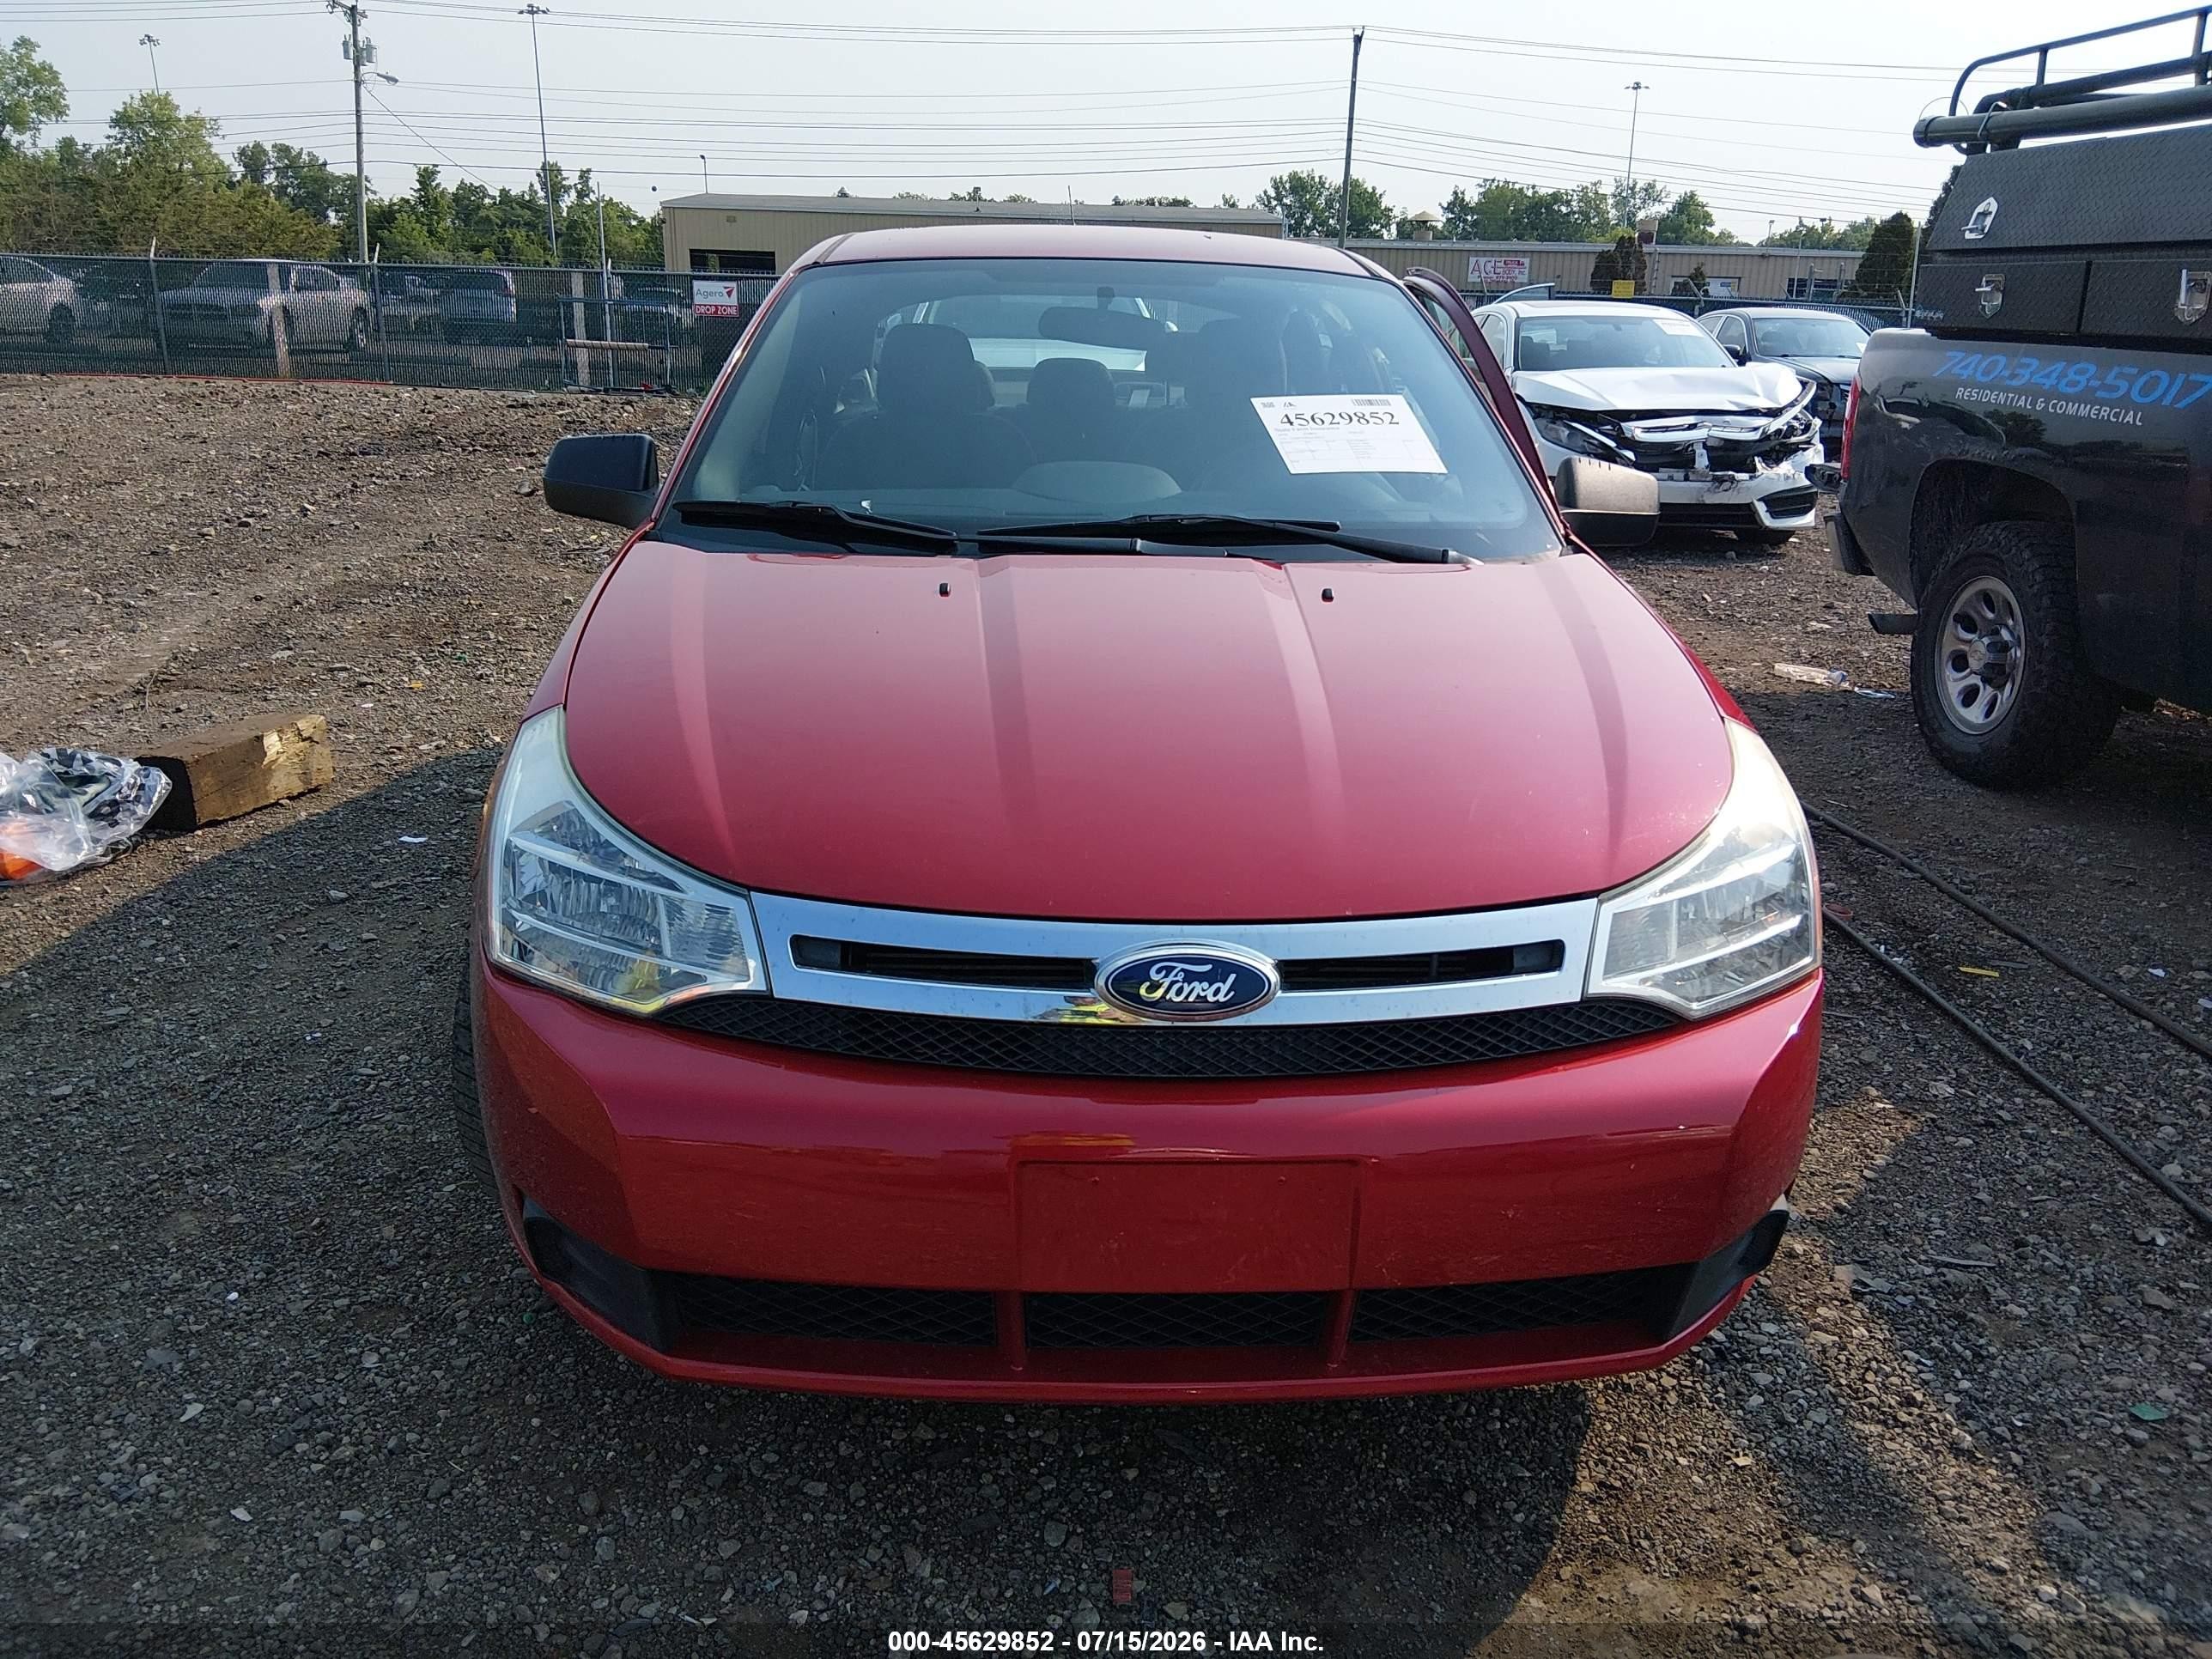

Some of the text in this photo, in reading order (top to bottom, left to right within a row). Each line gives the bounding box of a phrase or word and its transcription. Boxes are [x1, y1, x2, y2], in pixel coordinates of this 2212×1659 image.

[1470, 259, 1502, 275] ACE
[696, 288, 724, 300] Agero
[696, 305, 738, 315] DROP ZONE
[1933, 350, 2212, 410] 740-348-5017
[1954, 386, 2143, 427] RESIDENTIAL & COMMERCIAL
[1280, 411, 1400, 427] 45629852
[1139, 961, 1237, 1003] Ford
